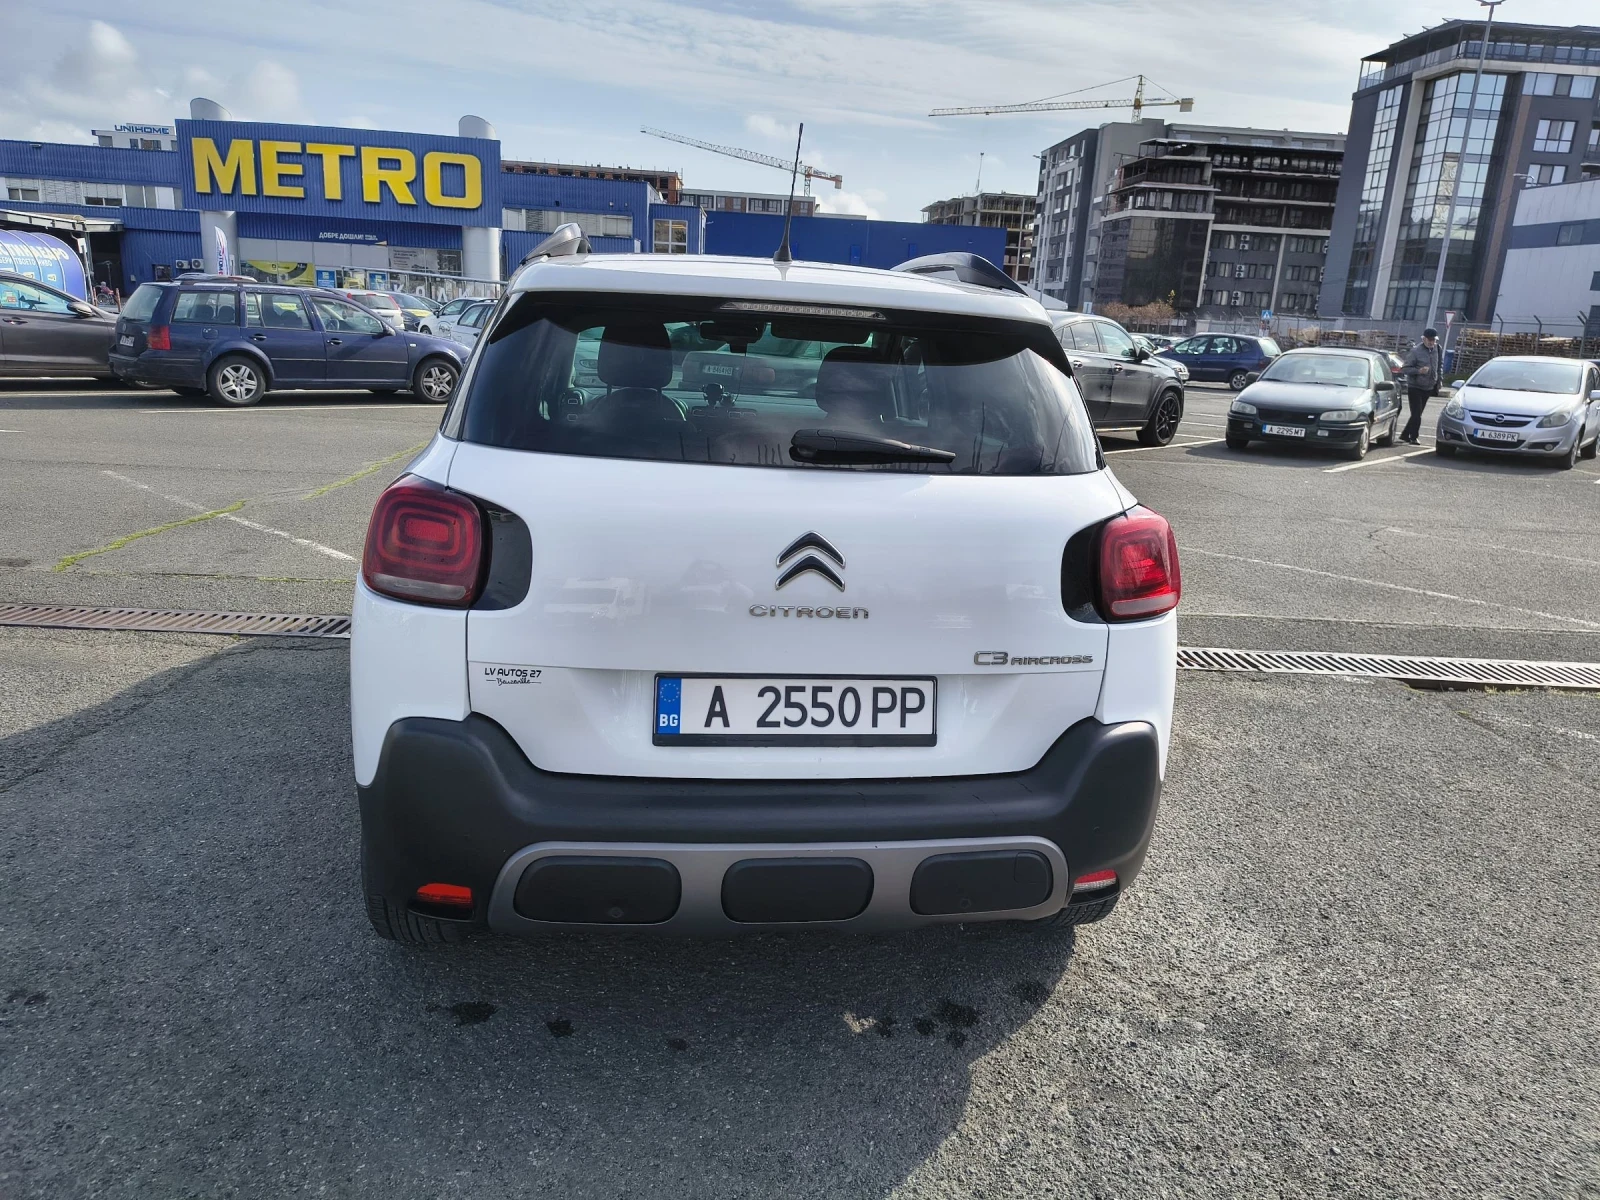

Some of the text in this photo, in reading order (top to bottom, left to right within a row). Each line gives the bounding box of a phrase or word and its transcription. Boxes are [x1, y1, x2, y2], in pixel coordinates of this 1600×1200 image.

[114, 124, 170, 134] UNIHOME
[192, 137, 483, 209] METRO
[974, 651, 1094, 665] C3 AIRCROSS
[484, 667, 542, 678] LV AUTOS 27
[704, 685, 730, 728] A
[659, 714, 679, 727] BG
